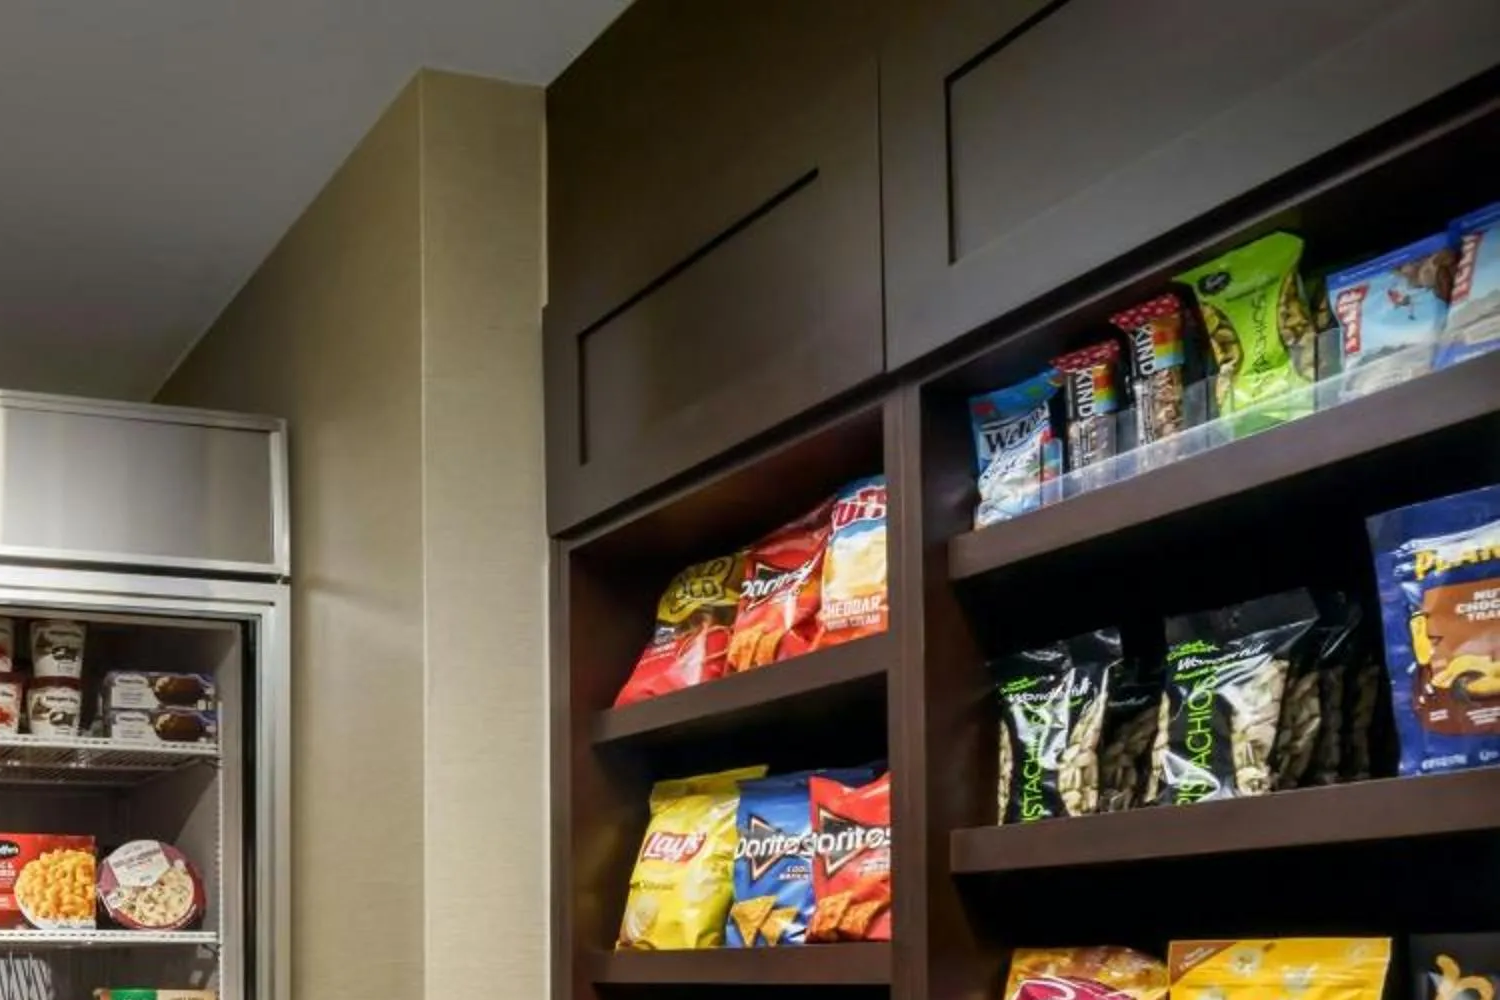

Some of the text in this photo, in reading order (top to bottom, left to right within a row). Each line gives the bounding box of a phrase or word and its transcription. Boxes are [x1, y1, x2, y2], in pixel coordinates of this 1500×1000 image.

[1135, 324, 1157, 377] KIND
[1075, 368, 1095, 417] KIND
[826, 596, 881, 617] HEDDAR
